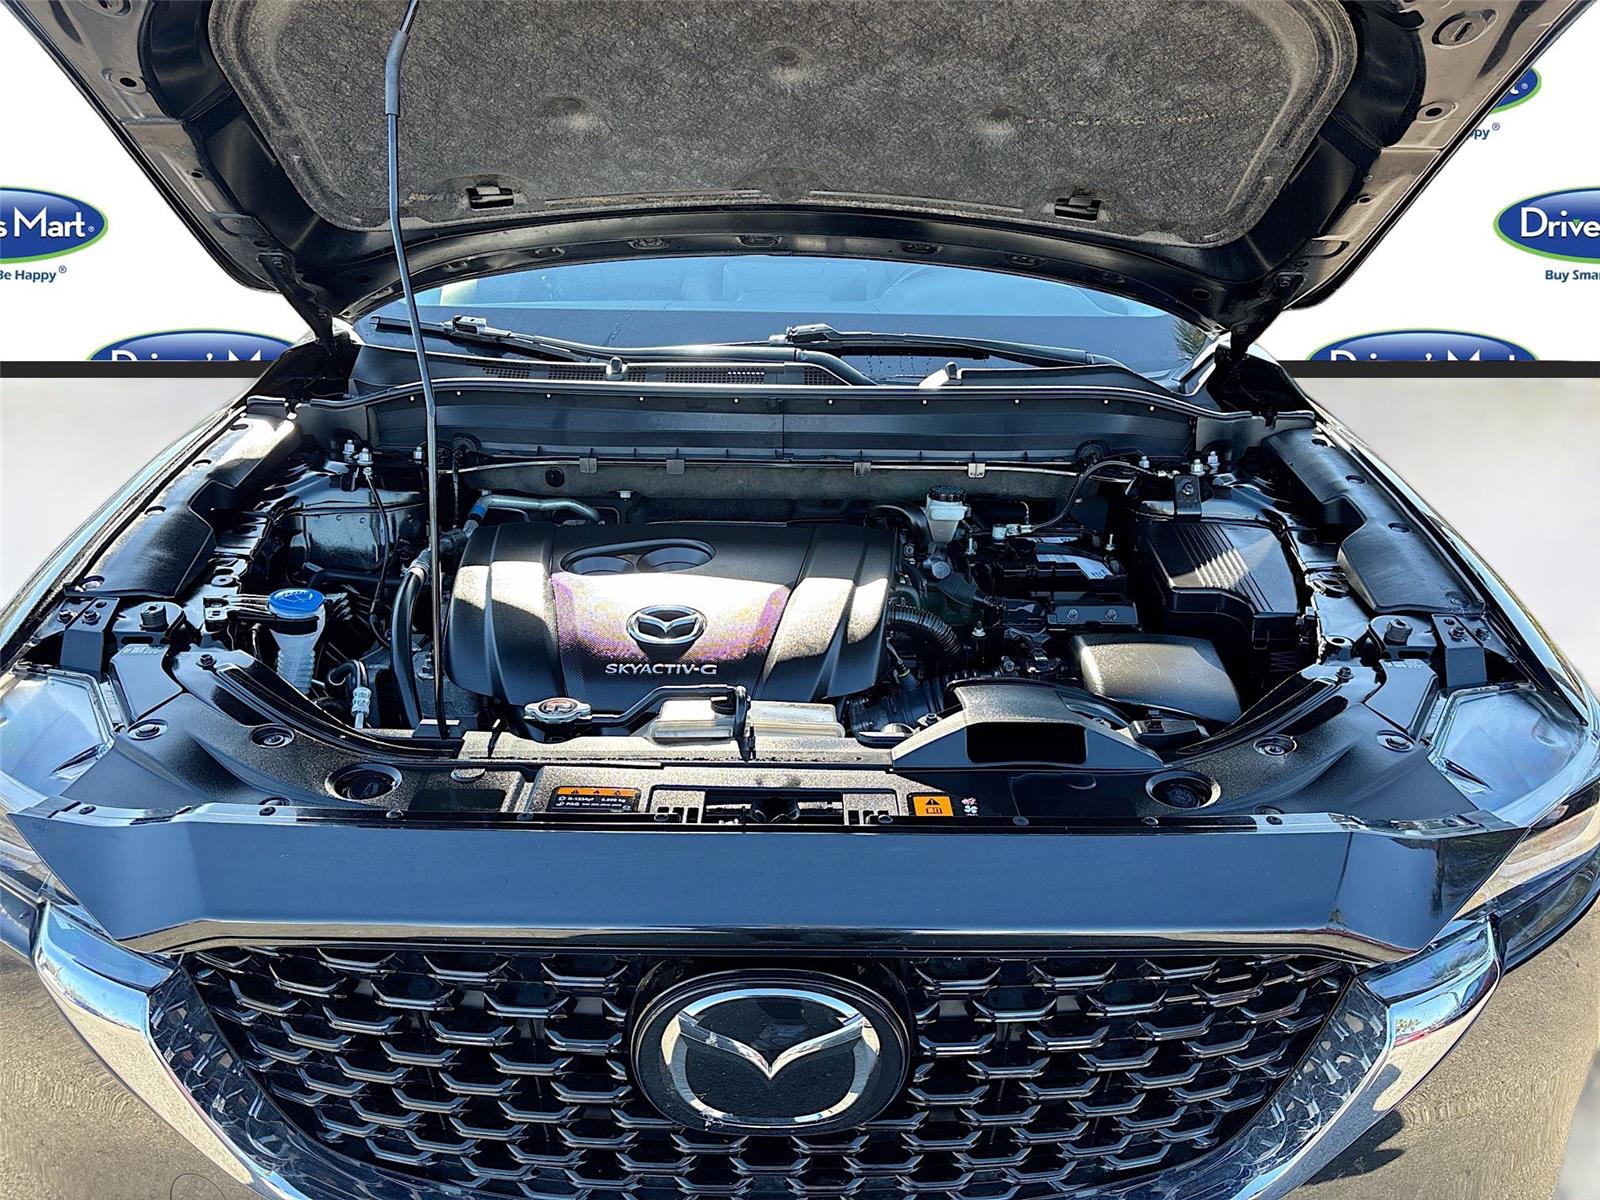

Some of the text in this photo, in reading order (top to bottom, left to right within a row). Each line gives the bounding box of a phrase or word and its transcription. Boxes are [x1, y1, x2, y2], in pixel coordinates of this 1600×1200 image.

[14, 206, 86, 238] Mart
[15, 269, 57, 283] Happy
[1545, 269, 1570, 283] Buy
[605, 663, 718, 675] SKYACTIV-G
